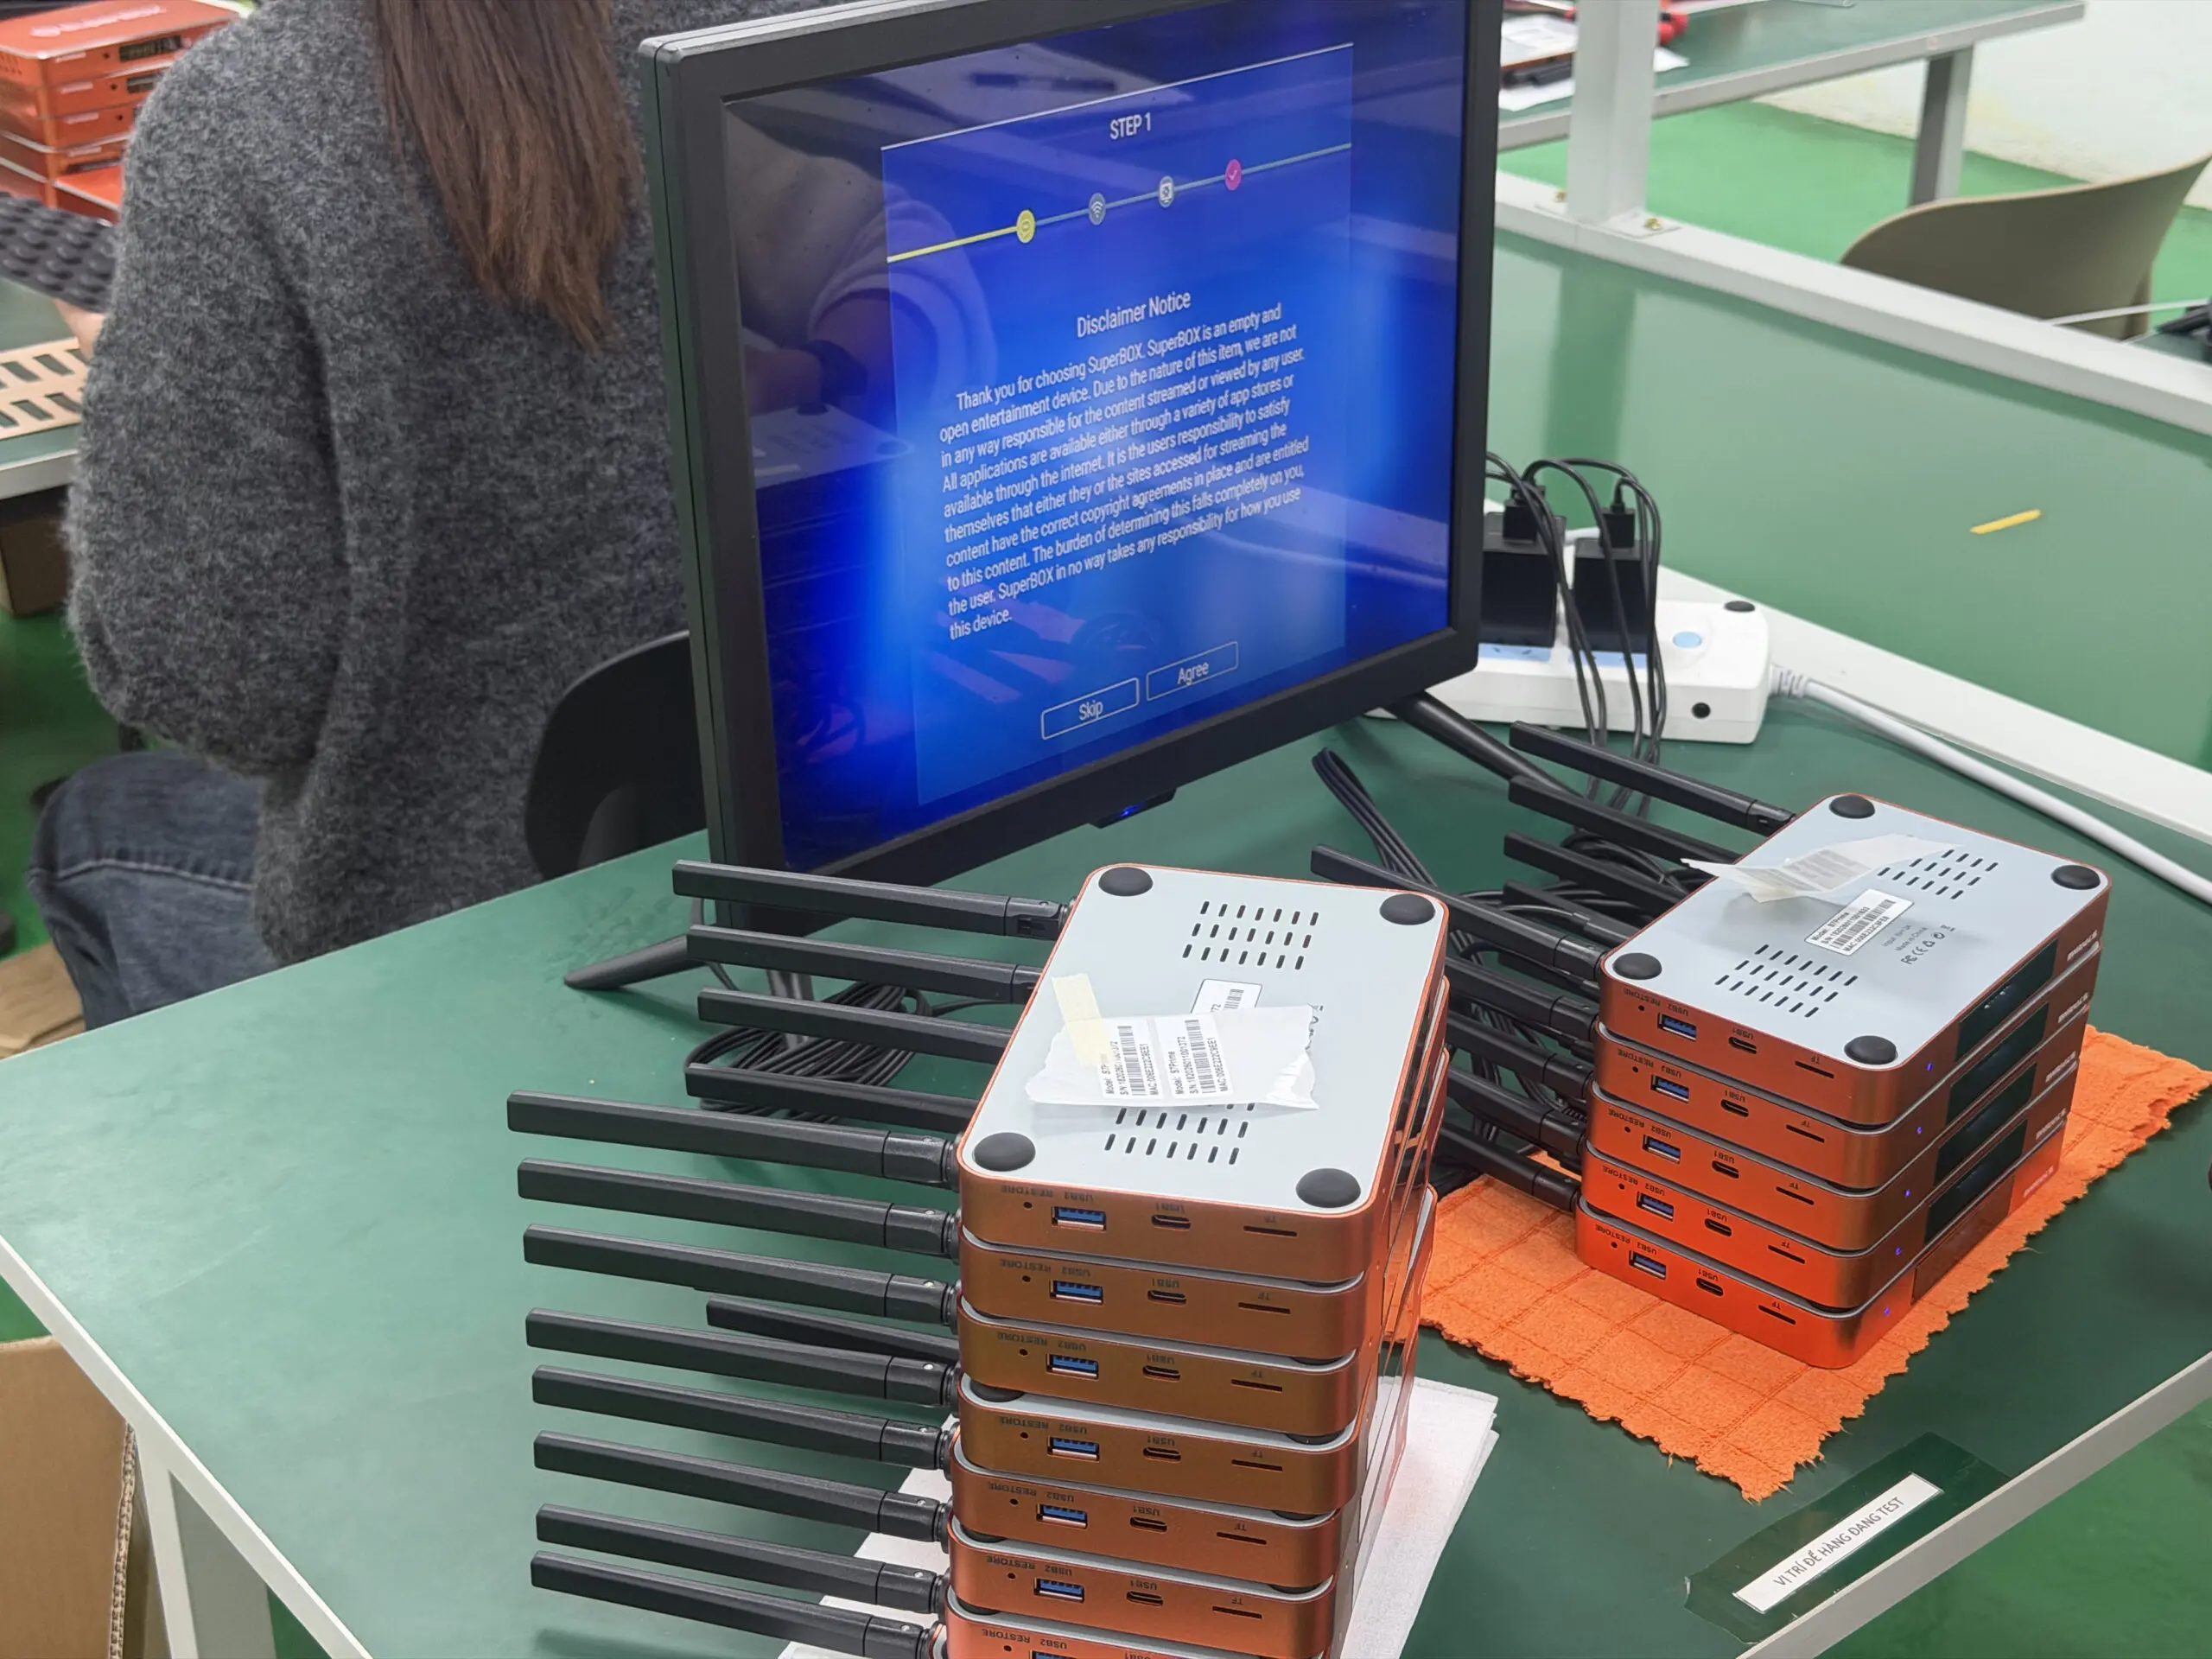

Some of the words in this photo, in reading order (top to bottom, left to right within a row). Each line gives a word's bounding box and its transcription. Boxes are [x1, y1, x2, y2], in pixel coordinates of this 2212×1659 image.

[1109, 114, 1142, 140] STEP
[1145, 111, 1151, 131] 1
[957, 386, 993, 411] Thank
[995, 385, 1015, 405] you
[1018, 376, 1033, 393] for
[1035, 363, 1086, 389] choosing
[1088, 342, 1145, 373] SuperBOX.
[1147, 326, 1201, 358] SuperBOX
[1203, 325, 1211, 340] is
[1213, 323, 1227, 337] an
[1229, 311, 1260, 333] empty
[1262, 302, 1281, 321] and
[1077, 304, 1147, 338] Disclaimer
[1149, 291, 1192, 318] Notice
[940, 423, 969, 444] open
[971, 396, 1050, 433] entertainment
[1052, 387, 1090, 410] device.
[1093, 378, 1115, 397] Due
[1117, 376, 1128, 391] to
[1130, 369, 1147, 386] the
[1149, 359, 1183, 380] nature
[1185, 353, 1196, 371] of
[1198, 350, 1217, 366] this
[1218, 342, 1243, 361] item,
[1245, 337, 1261, 353] we
[1262, 332, 1279, 346] are
[1280, 325, 1297, 342] not
[942, 451, 951, 467] in
[955, 445, 975, 464] any
[977, 438, 1000, 457] way
[1001, 418, 1065, 450] responsible
[1068, 412, 1083, 429] for
[1085, 406, 1103, 423] the
[1104, 395, 1145, 418] content
[1147, 376, 1196, 406] streamed
[1198, 378, 1209, 390] or
[1211, 362, 1246, 386] viewed
[1248, 359, 1260, 378] by
[1262, 355, 1280, 372] any
[1281, 347, 1305, 366] user.
[943, 475, 957, 493] All
[959, 455, 1028, 490] applications
[1030, 452, 1048, 466] are
[1050, 435, 1096, 460] available
[1098, 425, 1128, 446] either
[1131, 410, 1172, 435] through
[1173, 410, 1180, 423] a
[1182, 397, 1217, 419] variety
[1217, 391, 1229, 409] of
[1230, 389, 1250, 406] app
[1252, 378, 1282, 397] stores
[1283, 374, 1294, 388] or
[944, 492, 994, 518] available
[995, 476, 1038, 502] through
[1041, 470, 1058, 487] the
[1061, 456, 1105, 480] internet.
[1108, 451, 1116, 467] It
[1117, 450, 1127, 465] is
[1128, 442, 1146, 460] the
[1147, 435, 1176, 454] users
[1178, 411, 1243, 442] responsibility
[1246, 409, 1256, 423] to
[1258, 397, 1290, 422] satisfy
[944, 511, 1009, 543] themselves
[1012, 504, 1033, 522] that
[1036, 493, 1066, 514] either
[1069, 485, 1091, 504] they
[1094, 482, 1106, 495] or
[1108, 474, 1125, 491] the
[1127, 467, 1152, 486] sites
[1154, 447, 1203, 474] accessed
[1204, 444, 1218, 461] for
[1219, 429, 1268, 455] streaming
[1270, 423, 1287, 437] the
[947, 541, 989, 567] content
[992, 533, 1019, 552] have
[1020, 526, 1039, 543] the
[1041, 515, 1079, 537] correct
[1081, 495, 1130, 523] copyright
[1132, 476, 1193, 509] agreements
[1194, 473, 1204, 487] in
[1205, 465, 1233, 486] place
[1235, 454, 1254, 474] and
[1255, 452, 1271, 467] are
[1273, 436, 1310, 461] entitled
[947, 576, 960, 592] to
[962, 568, 982, 587] this
[985, 553, 1031, 580] content.
[1033, 546, 1054, 563] The
[1056, 535, 1093, 556] burden
[1096, 524, 1106, 543] of
[1108, 508, 1170, 540] determining
[1172, 501, 1190, 518] this
[1192, 493, 1213, 511] falls
[1215, 474, 1268, 503] completely
[1269, 472, 1283, 486] on
[949, 599, 967, 616] the
[970, 589, 995, 609] user.
[998, 567, 1054, 600] SuperBOX
[1056, 565, 1065, 580] in
[1068, 560, 1083, 575] no
[1084, 554, 1105, 571] way
[1107, 543, 1135, 563] takes
[1137, 536, 1156, 553] any
[1157, 513, 1224, 546] responsibility
[1225, 507, 1240, 524] for
[1241, 501, 1262, 518] how
[1263, 494, 1281, 515] you
[1283, 487, 1301, 503] use
[950, 620, 971, 640] this
[973, 608, 1013, 632] device.
[1178, 662, 1209, 685] Agree
[1078, 700, 1103, 721] Skip
[1773, 1575, 1792, 1586] VỊ
[1784, 1561, 1807, 1578] TRÍ
[1802, 1550, 1822, 1567] ĐỂ
[1818, 1534, 1852, 1556] HÀNG
[1847, 1513, 1881, 1535] ĐANG
[1876, 1497, 1904, 1516] TEST
